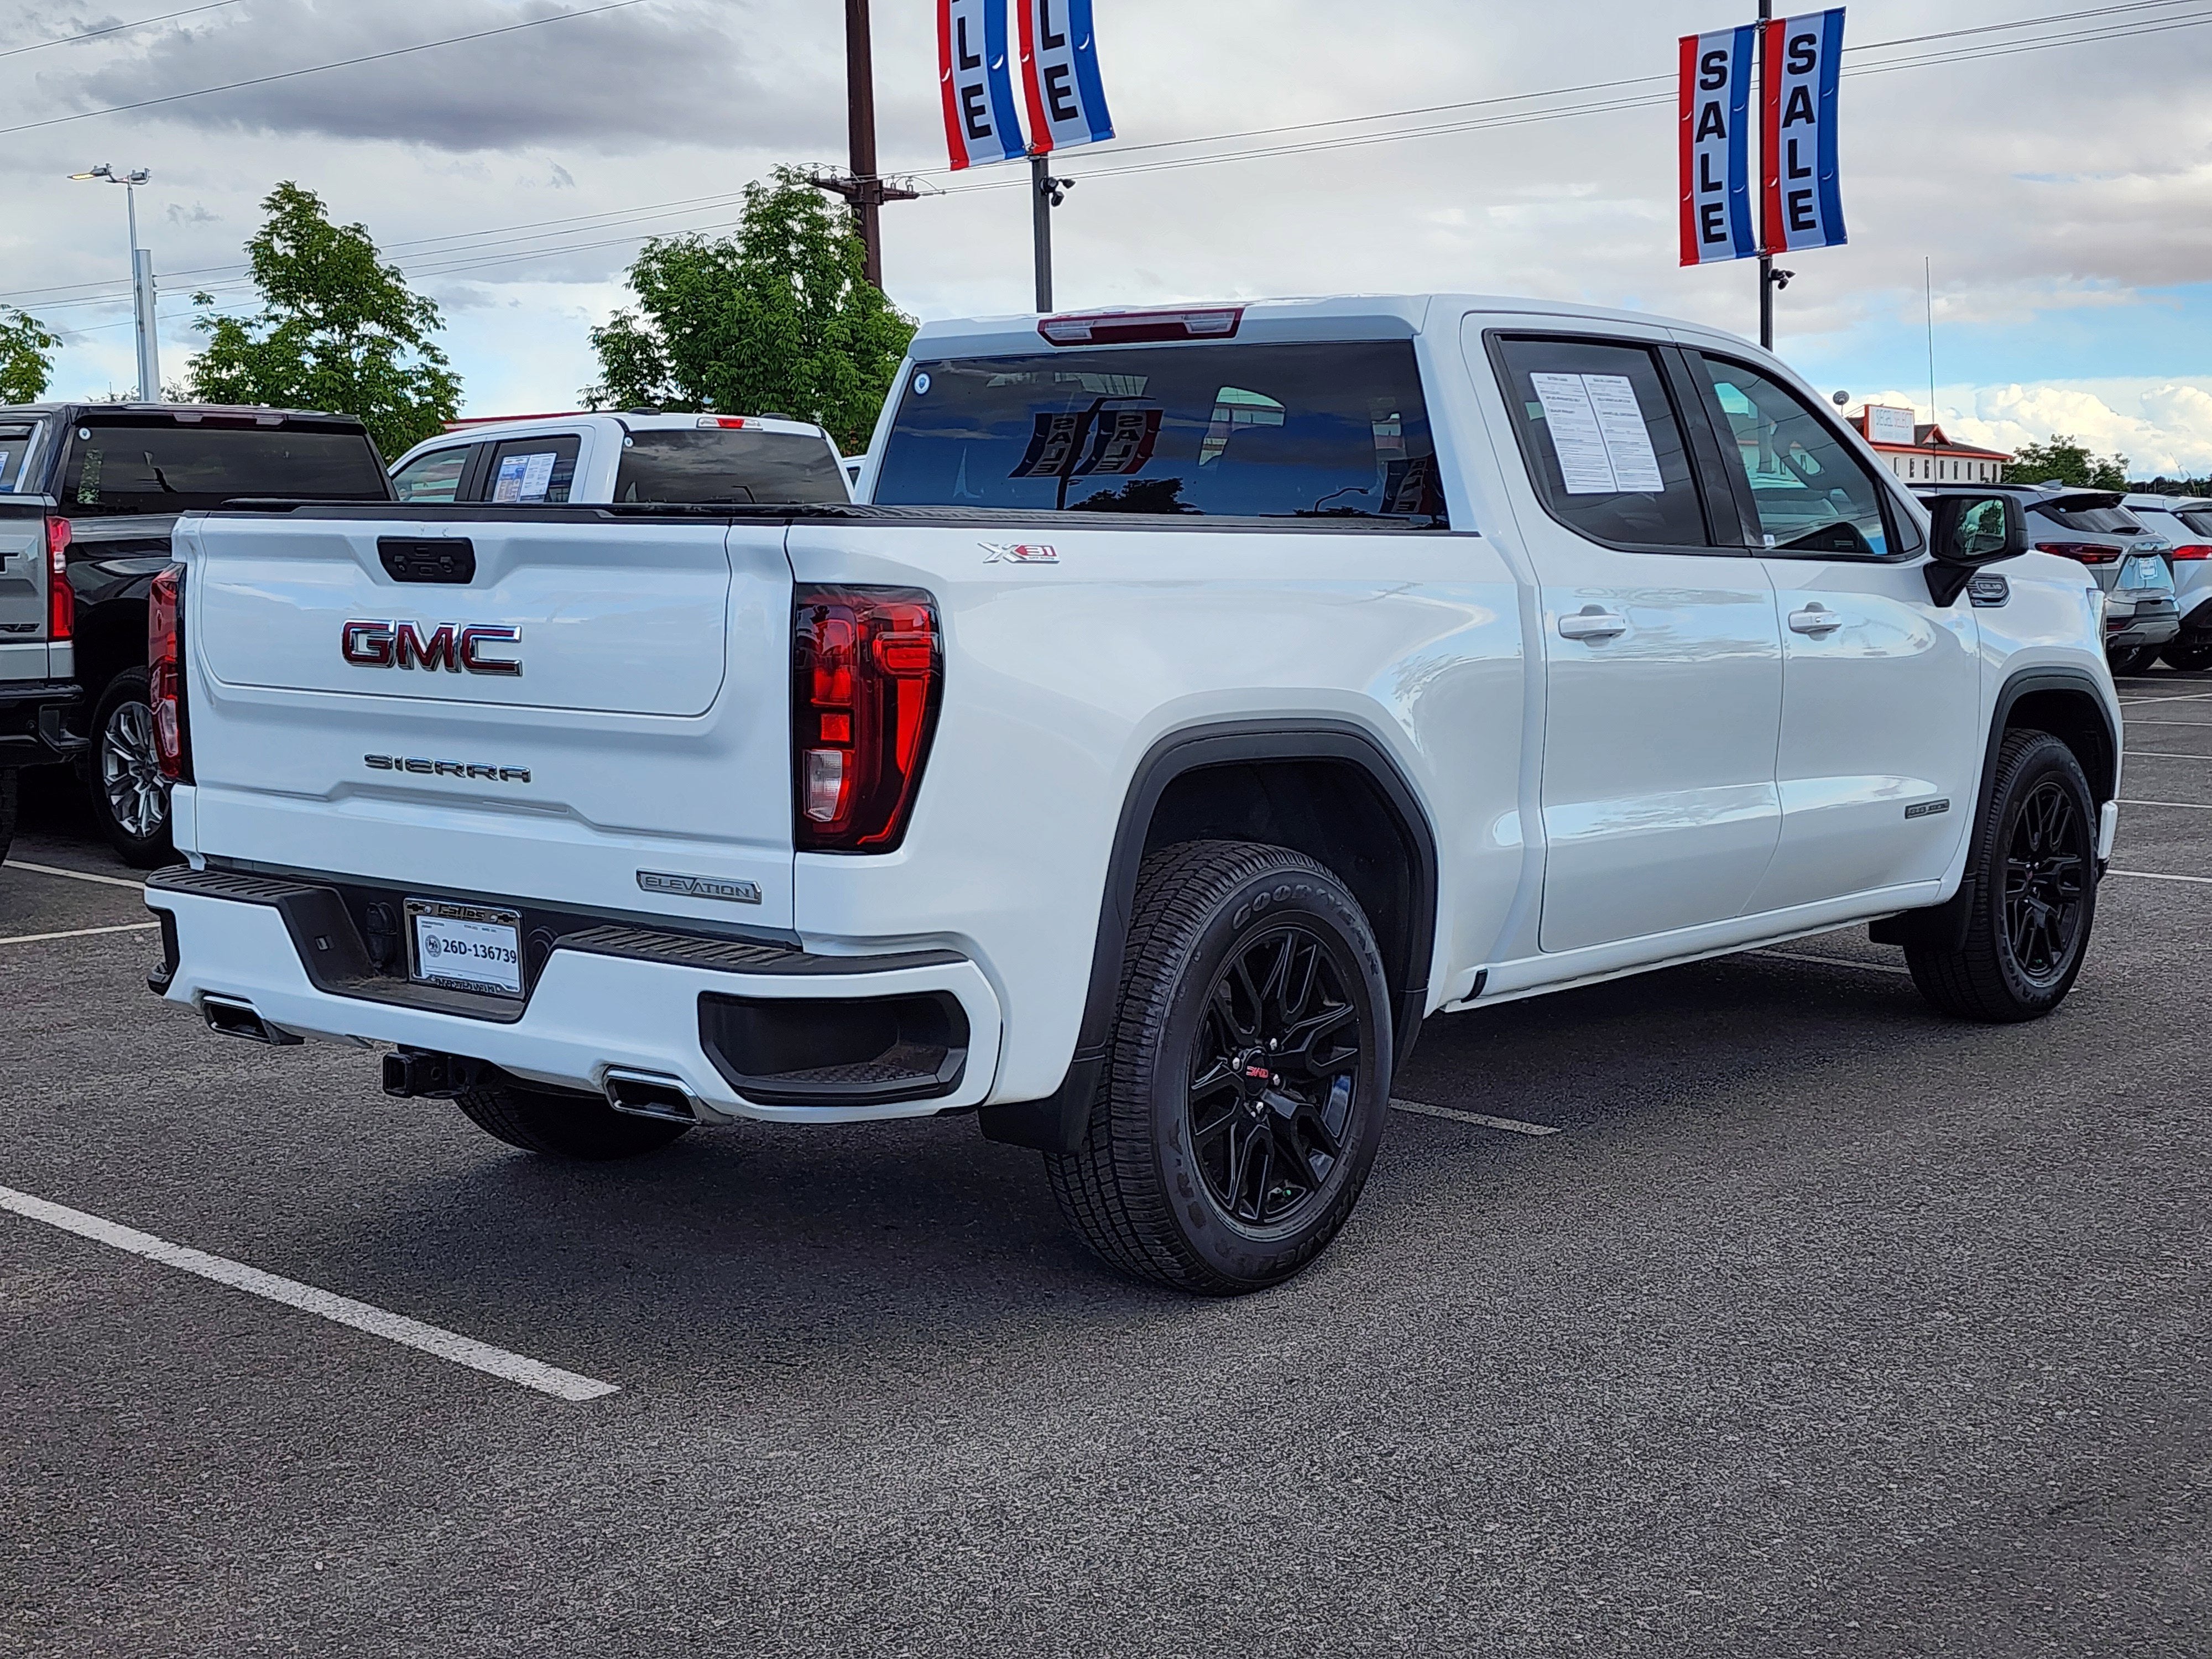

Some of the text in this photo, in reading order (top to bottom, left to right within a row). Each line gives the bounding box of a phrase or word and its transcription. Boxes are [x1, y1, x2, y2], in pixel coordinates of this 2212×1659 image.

[953, 0, 992, 140] LE
[1695, 50, 1728, 244] SALE
[1782, 34, 1817, 232] SALE
[342, 618, 523, 677] GMC
[364, 753, 531, 783] SIERRA
[645, 876, 751, 898] ELEVATION
[442, 939, 517, 964] 26D-136739
